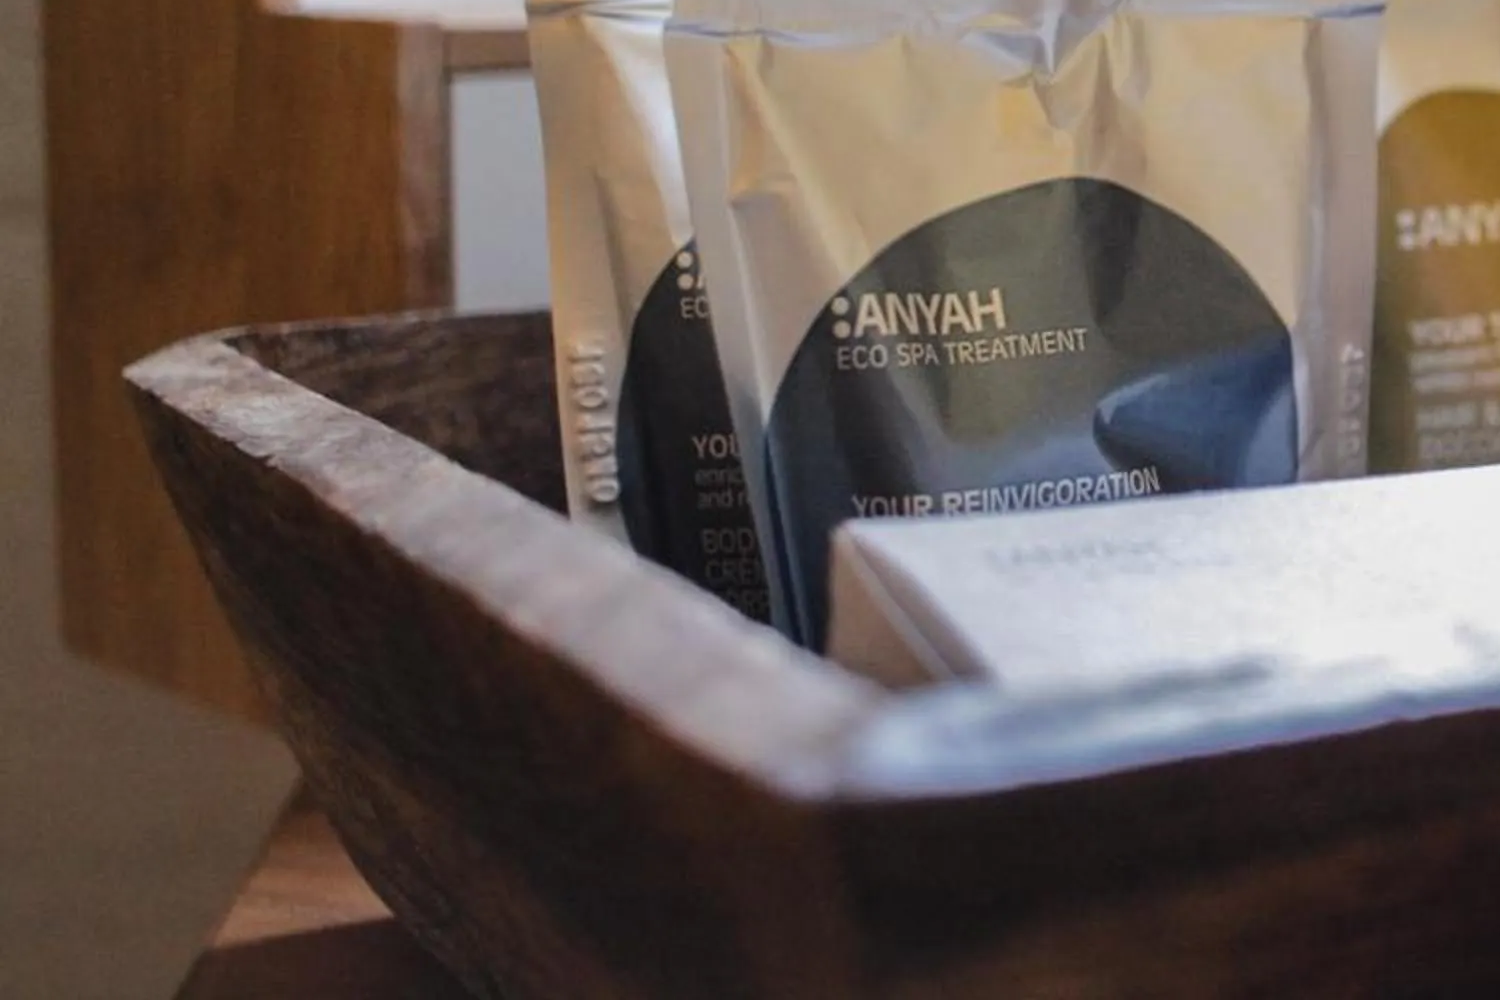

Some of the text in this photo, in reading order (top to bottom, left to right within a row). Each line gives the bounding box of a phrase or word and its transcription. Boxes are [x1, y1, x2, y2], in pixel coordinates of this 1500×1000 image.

[680, 296, 710, 319] EC
[836, 327, 1088, 370] ECO SPA TREATMENT
[691, 432, 740, 460] YOU
[851, 464, 1161, 519] YOUR REINVIGORATION
[702, 526, 755, 555] BOD
